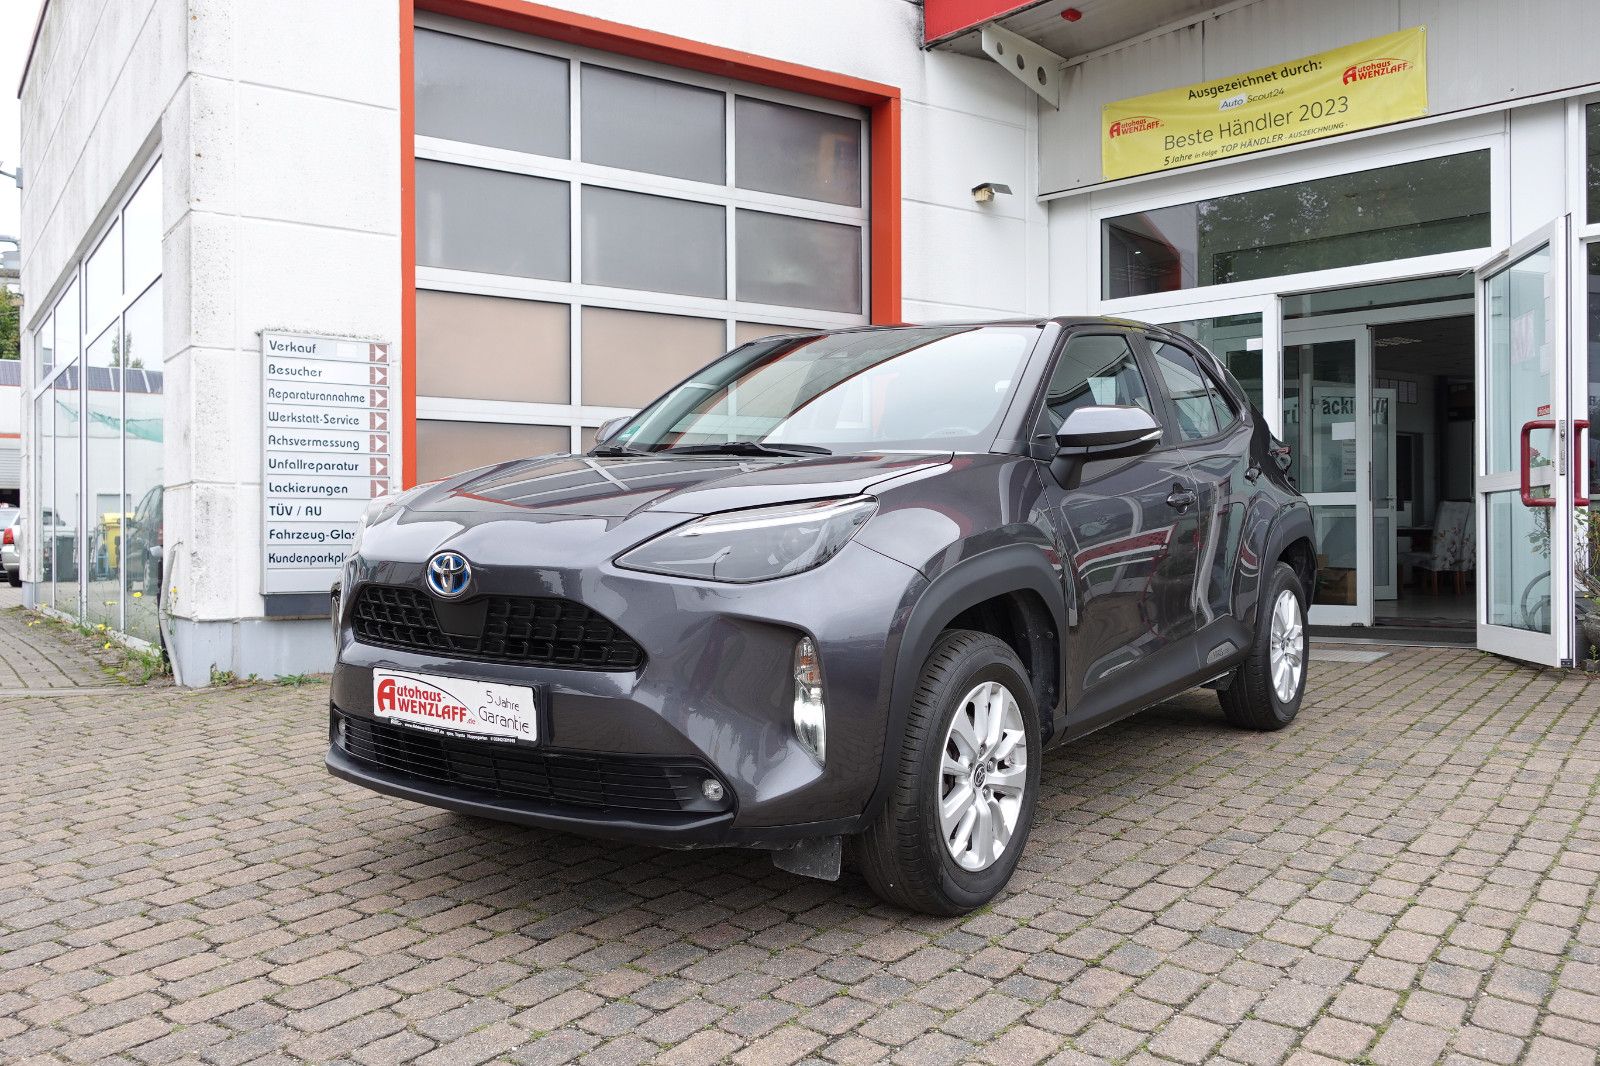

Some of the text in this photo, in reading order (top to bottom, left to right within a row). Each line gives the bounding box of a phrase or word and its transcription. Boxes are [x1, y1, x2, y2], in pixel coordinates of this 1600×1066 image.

[1188, 60, 1323, 100] Ausgezeichnet durch:
[1220, 87, 1285, 110] Auto Scout24
[1164, 95, 1350, 151] Beste Händler 2023
[1164, 156, 1171, 167] 5
[1171, 152, 1193, 164] Jahre
[1221, 142, 1240, 153] TOP
[1240, 132, 1284, 149] HÄNDLER
[269, 340, 317, 354] Verkauf
[268, 363, 323, 378] Besucher
[268, 387, 366, 403] Reparaturannahme
[268, 411, 360, 426] Werkstatt-Service
[268, 434, 360, 451] Achsvermessung
[268, 458, 360, 473] Unfallreparatur
[269, 482, 349, 497] Lackierungen
[269, 503, 293, 516] TÜV
[305, 506, 322, 516] AU
[486, 690, 520, 712] 5 Jahre
[478, 706, 530, 734] Garantie
